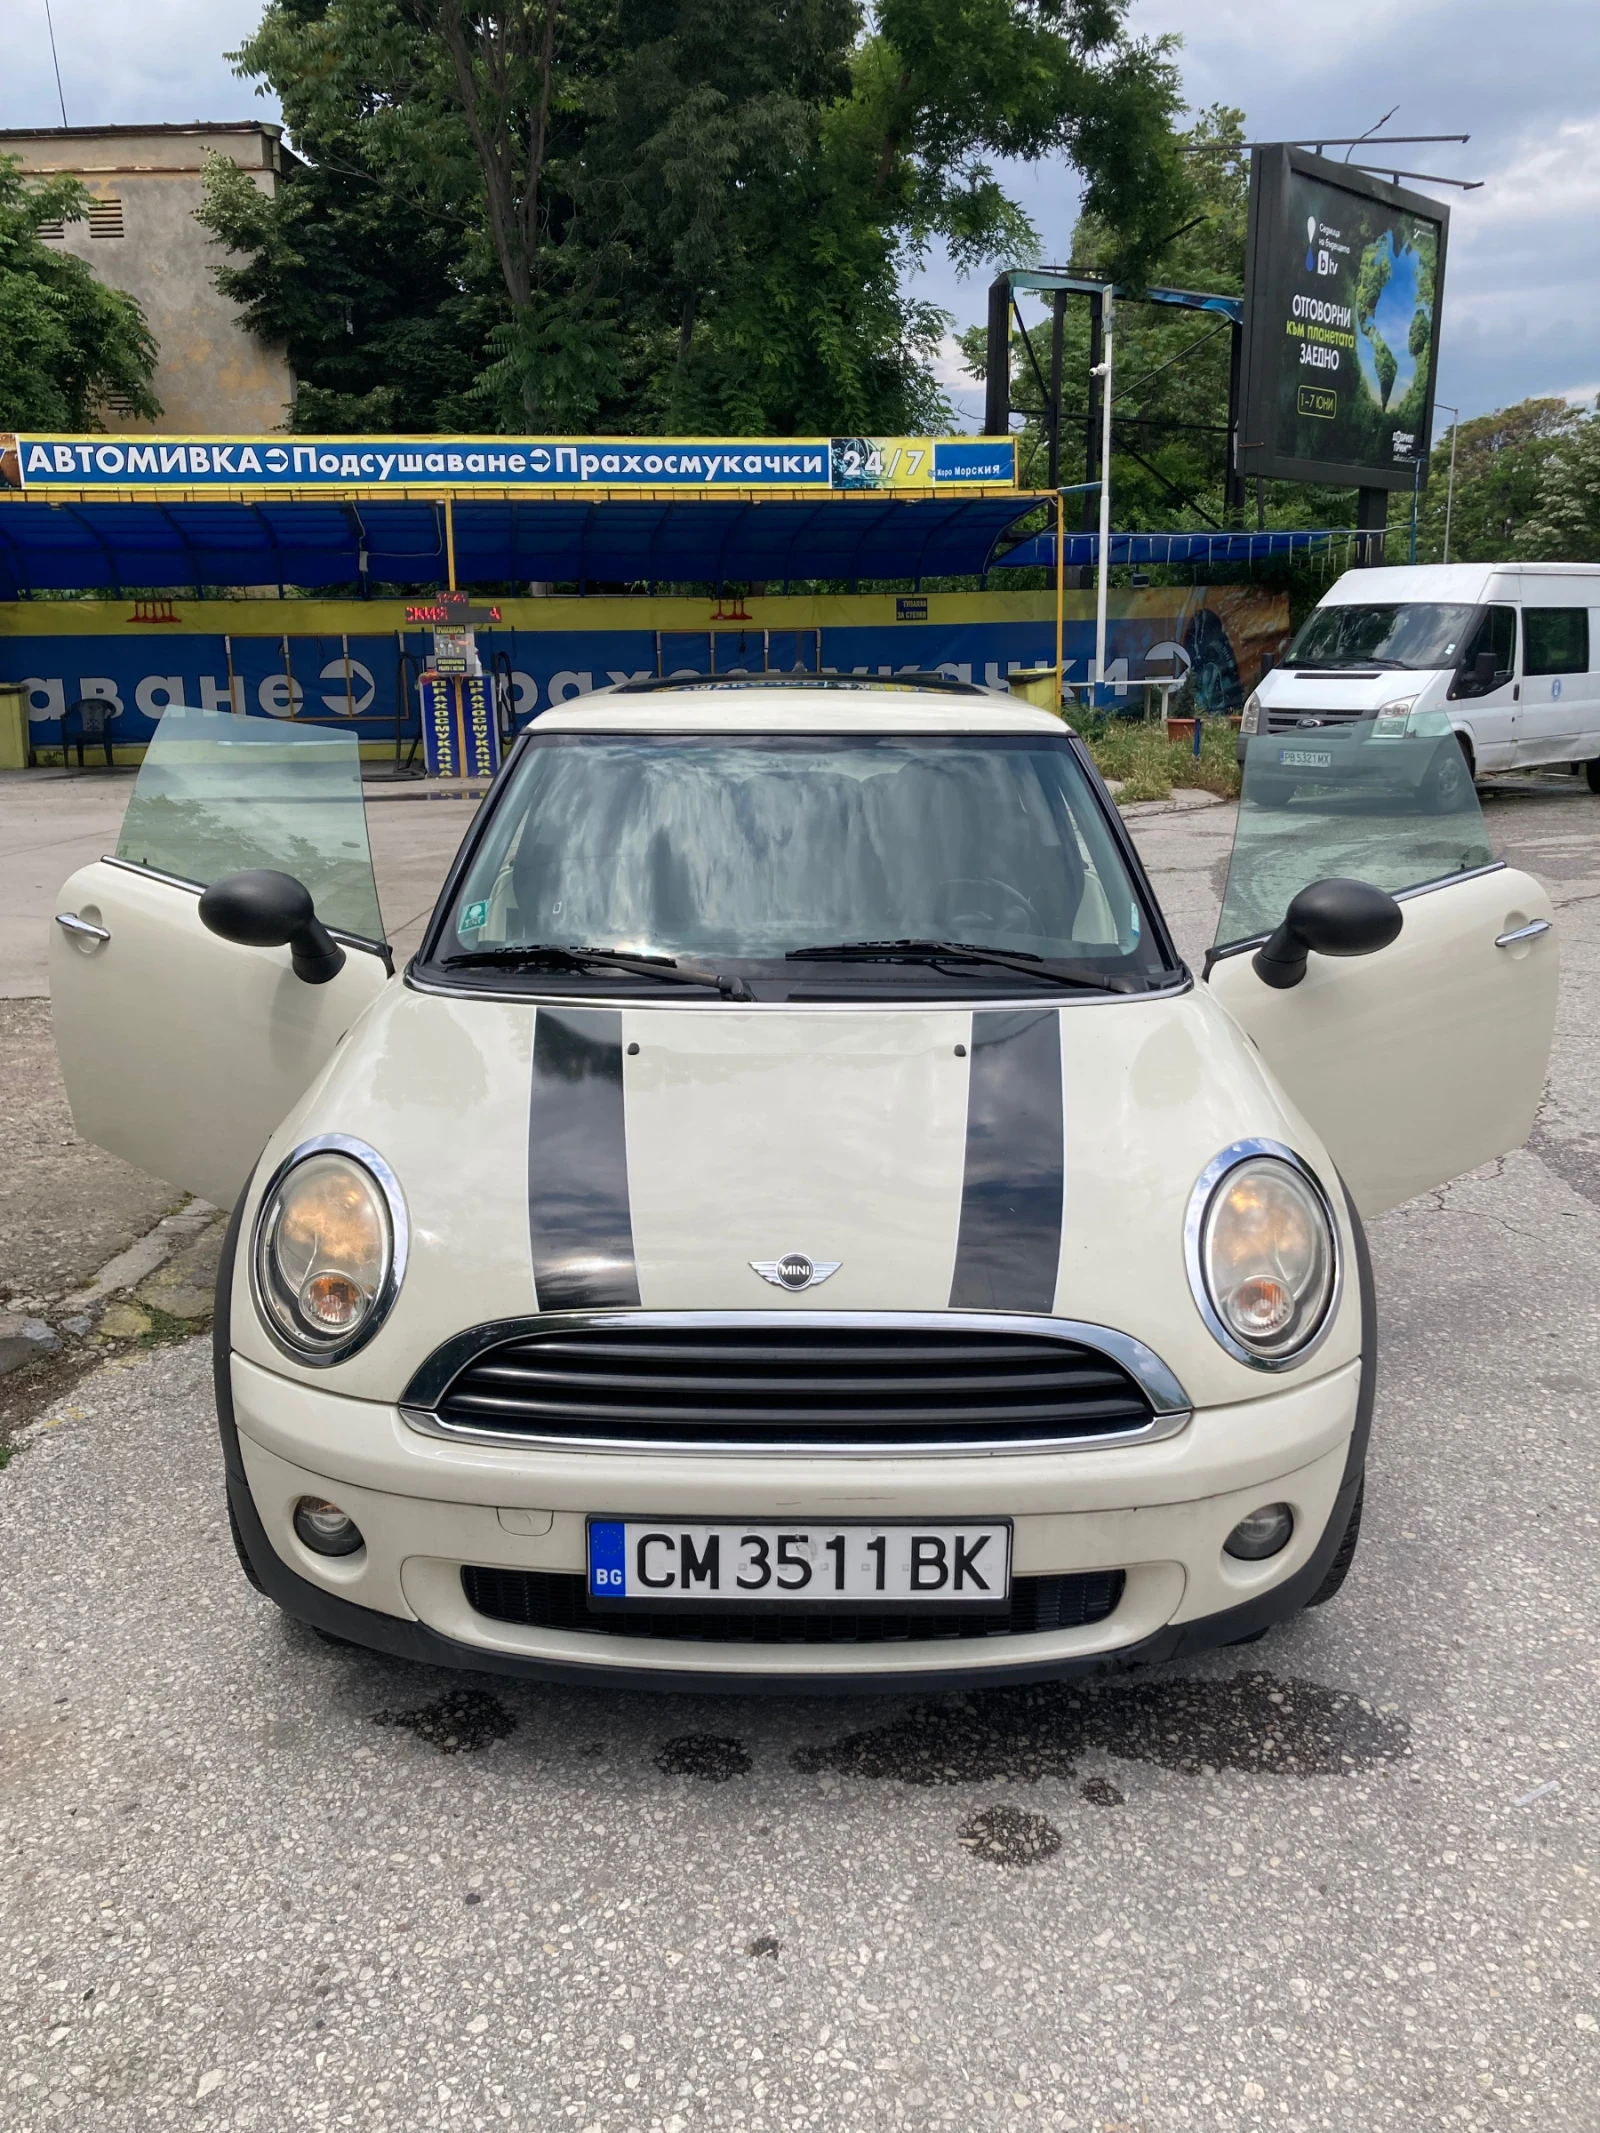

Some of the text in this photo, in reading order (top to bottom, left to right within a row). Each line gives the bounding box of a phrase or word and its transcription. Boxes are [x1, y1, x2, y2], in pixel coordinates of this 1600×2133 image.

[1292, 294, 1351, 328] ОТГОВОРНИ
[1307, 325, 1355, 349] планетата
[1299, 343, 1340, 371] ЗАЕДНО
[1315, 395, 1333, 411] ЮНИ
[26, 445, 264, 475] АВТОМИВКА
[292, 446, 527, 481] Подсушаване
[555, 447, 823, 482] Прахосмукачки
[842, 447, 926, 479] 24/7
[954, 464, 1000, 478] Морския
[431, 680, 453, 777] ПРАХОСМУКАЧКА
[468, 680, 492, 776] ПРАХОСМУКАЧКА
[781, 1265, 810, 1275] MINI
[596, 1568, 622, 1586] BG
